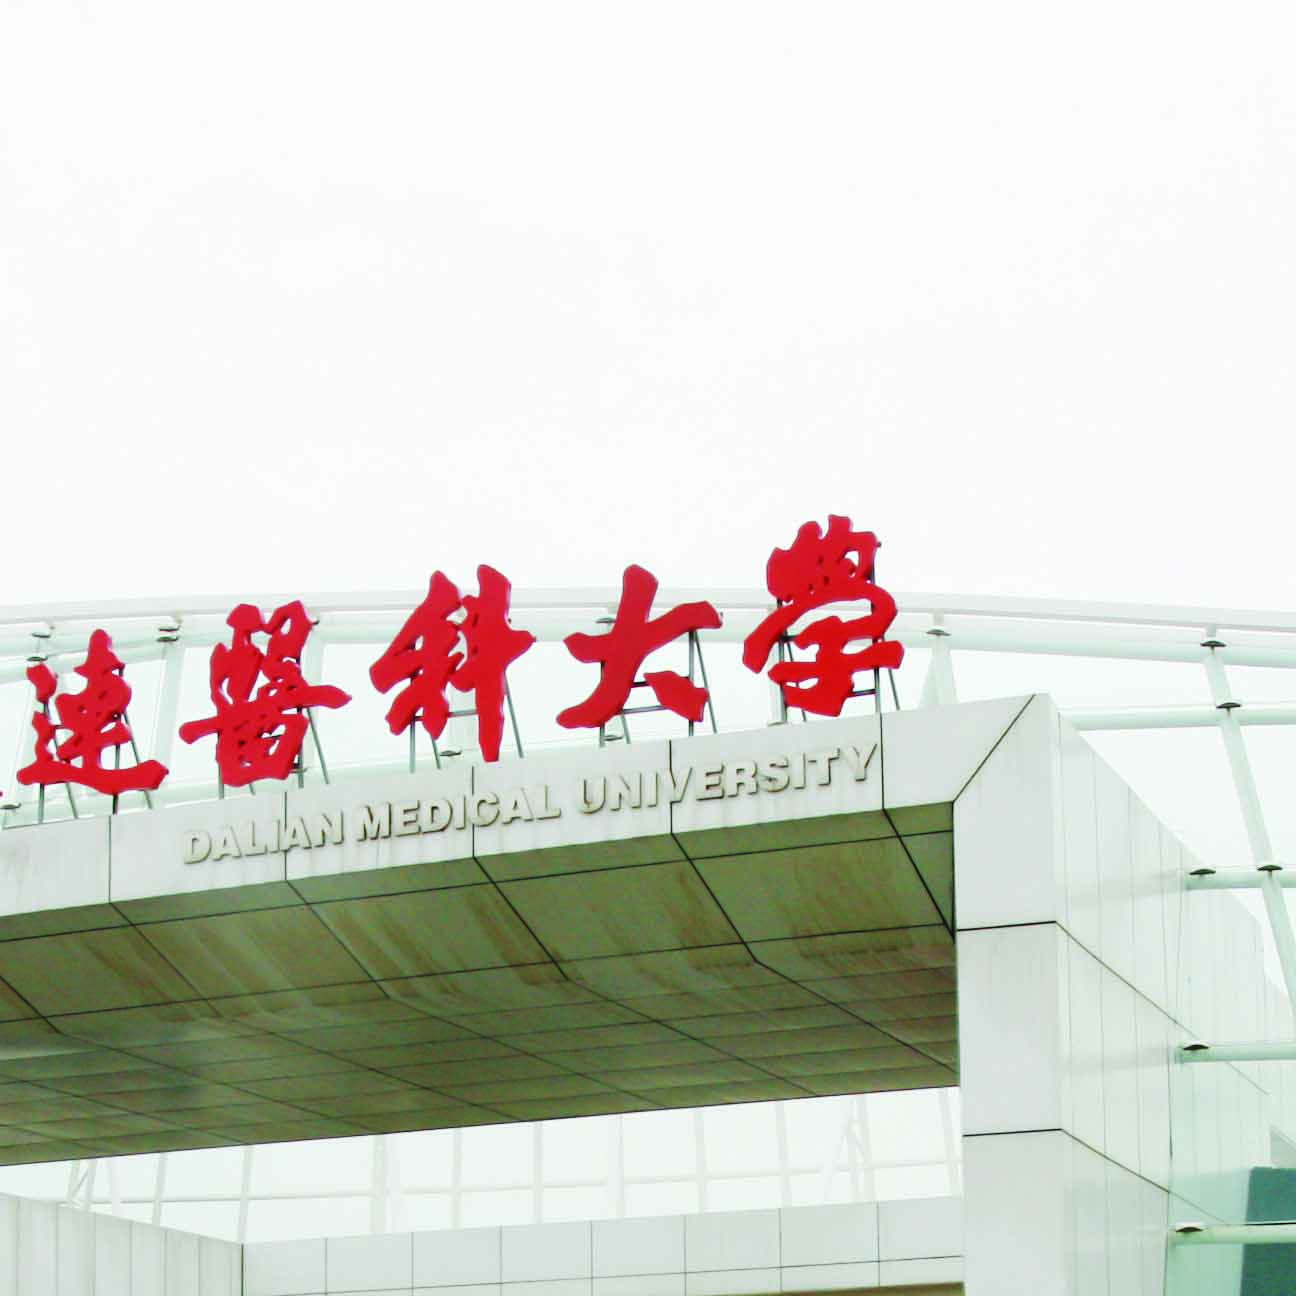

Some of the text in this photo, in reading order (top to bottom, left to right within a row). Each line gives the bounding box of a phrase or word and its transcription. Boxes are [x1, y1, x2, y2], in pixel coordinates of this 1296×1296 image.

[183, 743, 878, 864] DALIAN MEDICAL UNIVERSITY
